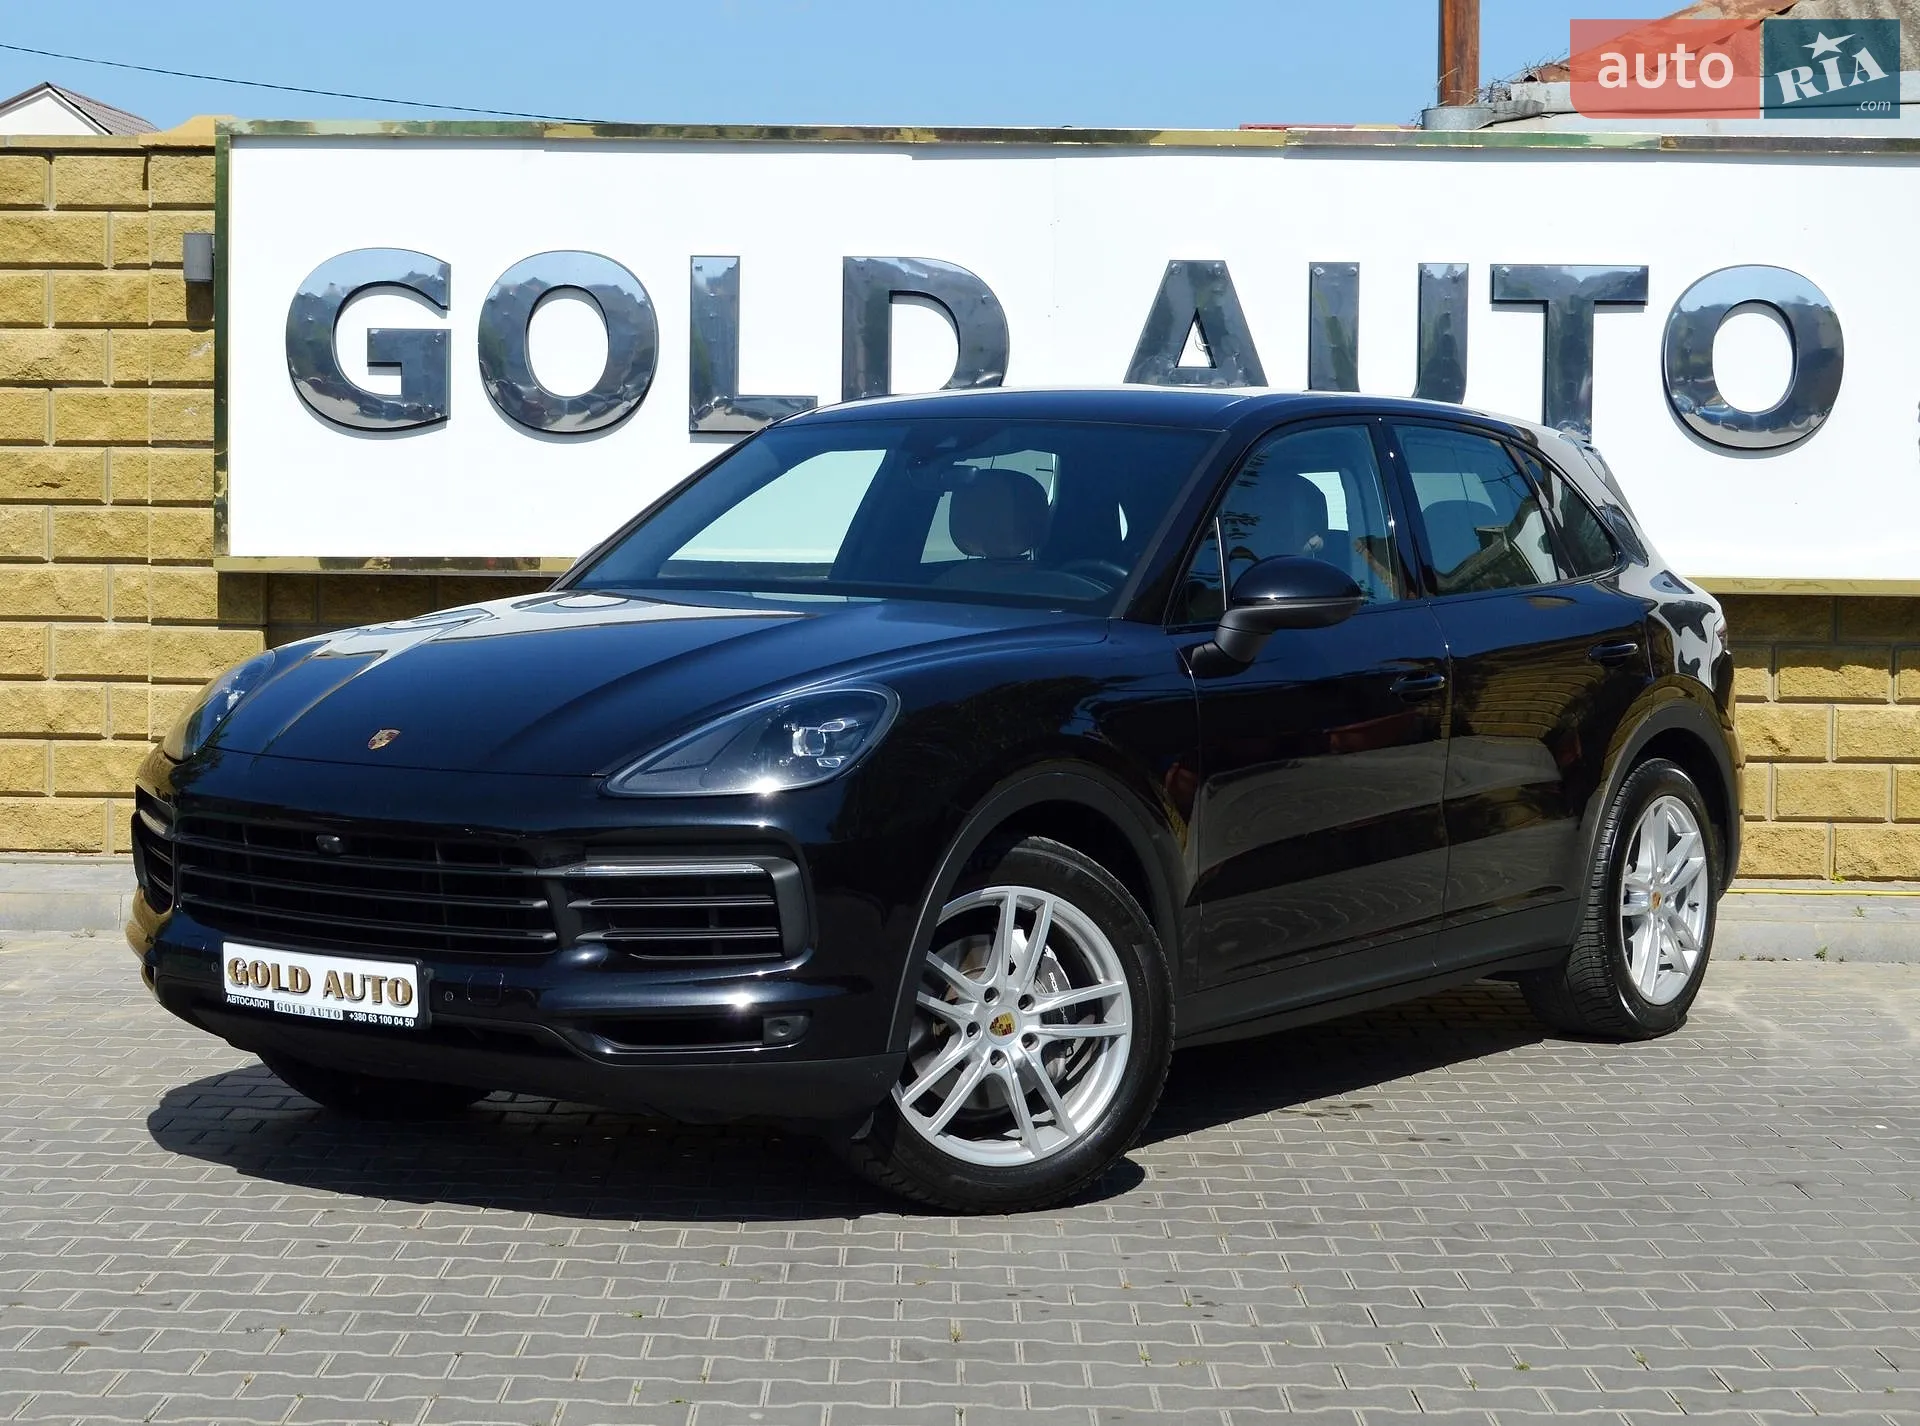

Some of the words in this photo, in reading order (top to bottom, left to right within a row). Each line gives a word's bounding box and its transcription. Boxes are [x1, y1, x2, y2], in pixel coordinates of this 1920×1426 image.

[285, 247, 1011, 436] GOLD
[1122, 258, 1845, 449] AUTO
[227, 957, 312, 996] GOLD
[322, 970, 413, 1008] AUTO
[226, 994, 270, 1009] АВТОСАЛОН
[276, 1000, 306, 1015] GOLD
[309, 1006, 341, 1019] AUTO
[349, 1011, 367, 1022] +380
[367, 1014, 378, 1024] 63
[379, 1015, 392, 1025] 100
[393, 1016, 404, 1026] 04
[404, 1017, 415, 1028] 50
